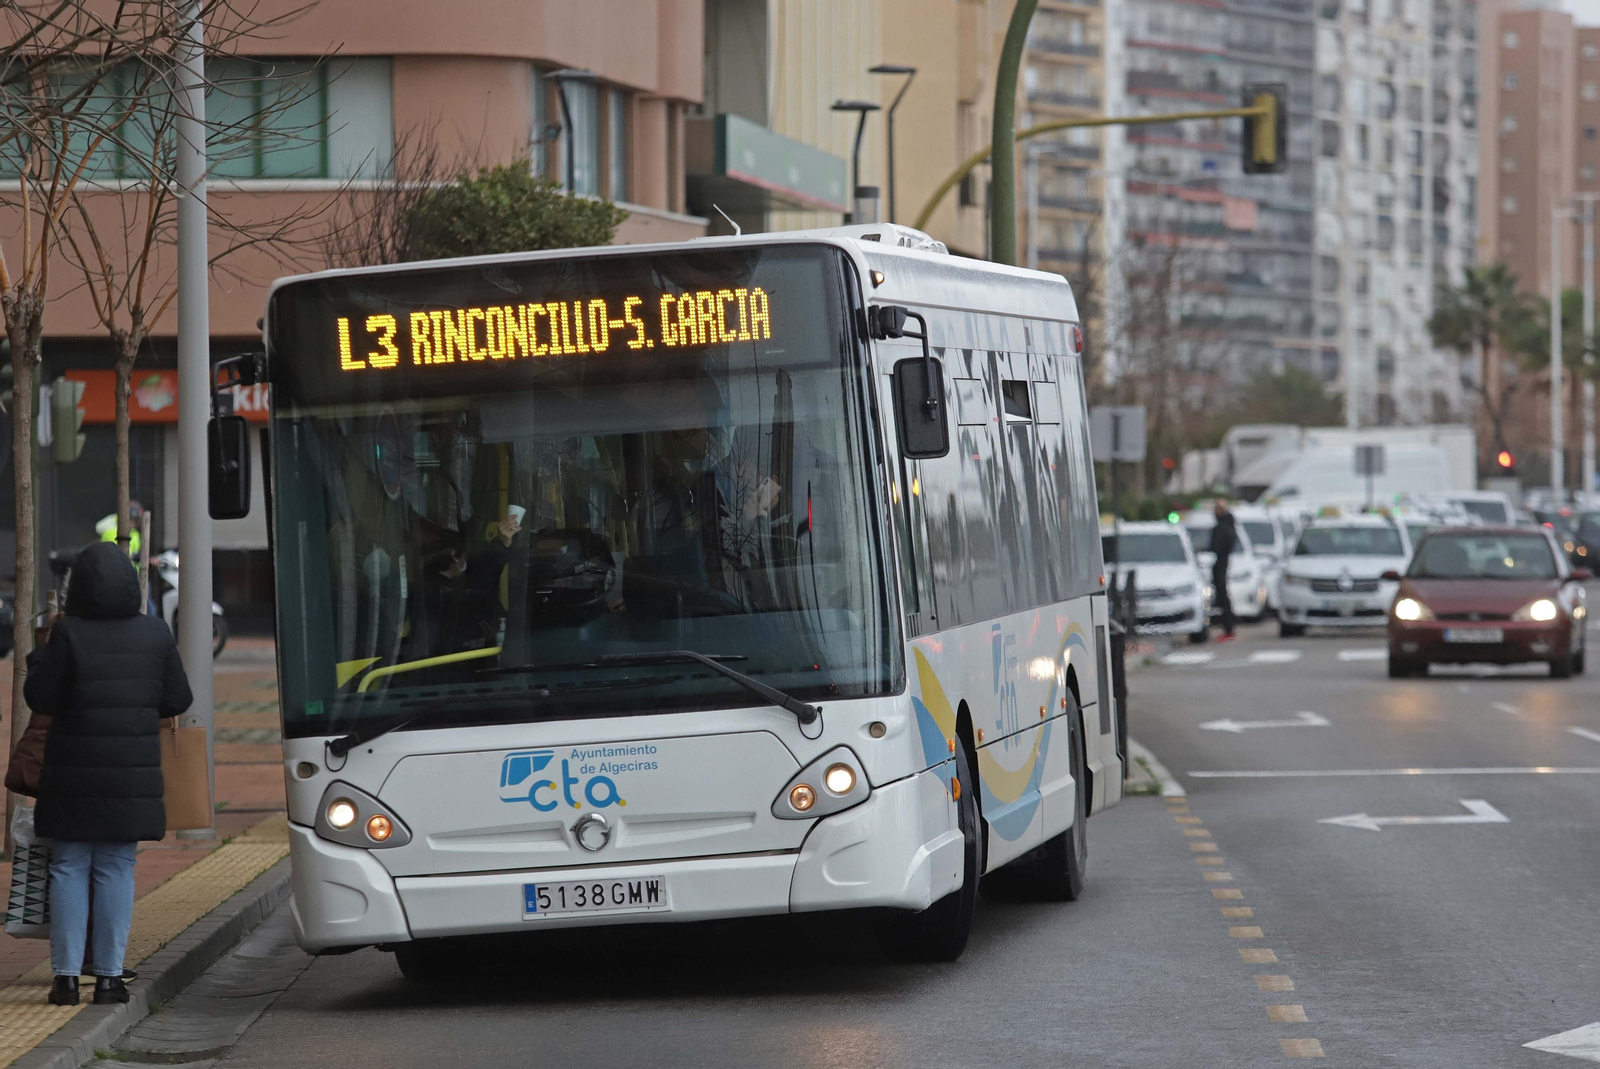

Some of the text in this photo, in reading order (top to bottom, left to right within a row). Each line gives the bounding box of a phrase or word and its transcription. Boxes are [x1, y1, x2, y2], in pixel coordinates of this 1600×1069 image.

[337, 314, 399, 370] L3
[660, 287, 771, 346] GARCIA
[570, 744, 658, 761] Ayuntamiento
[580, 761, 659, 776] de Algeciras
